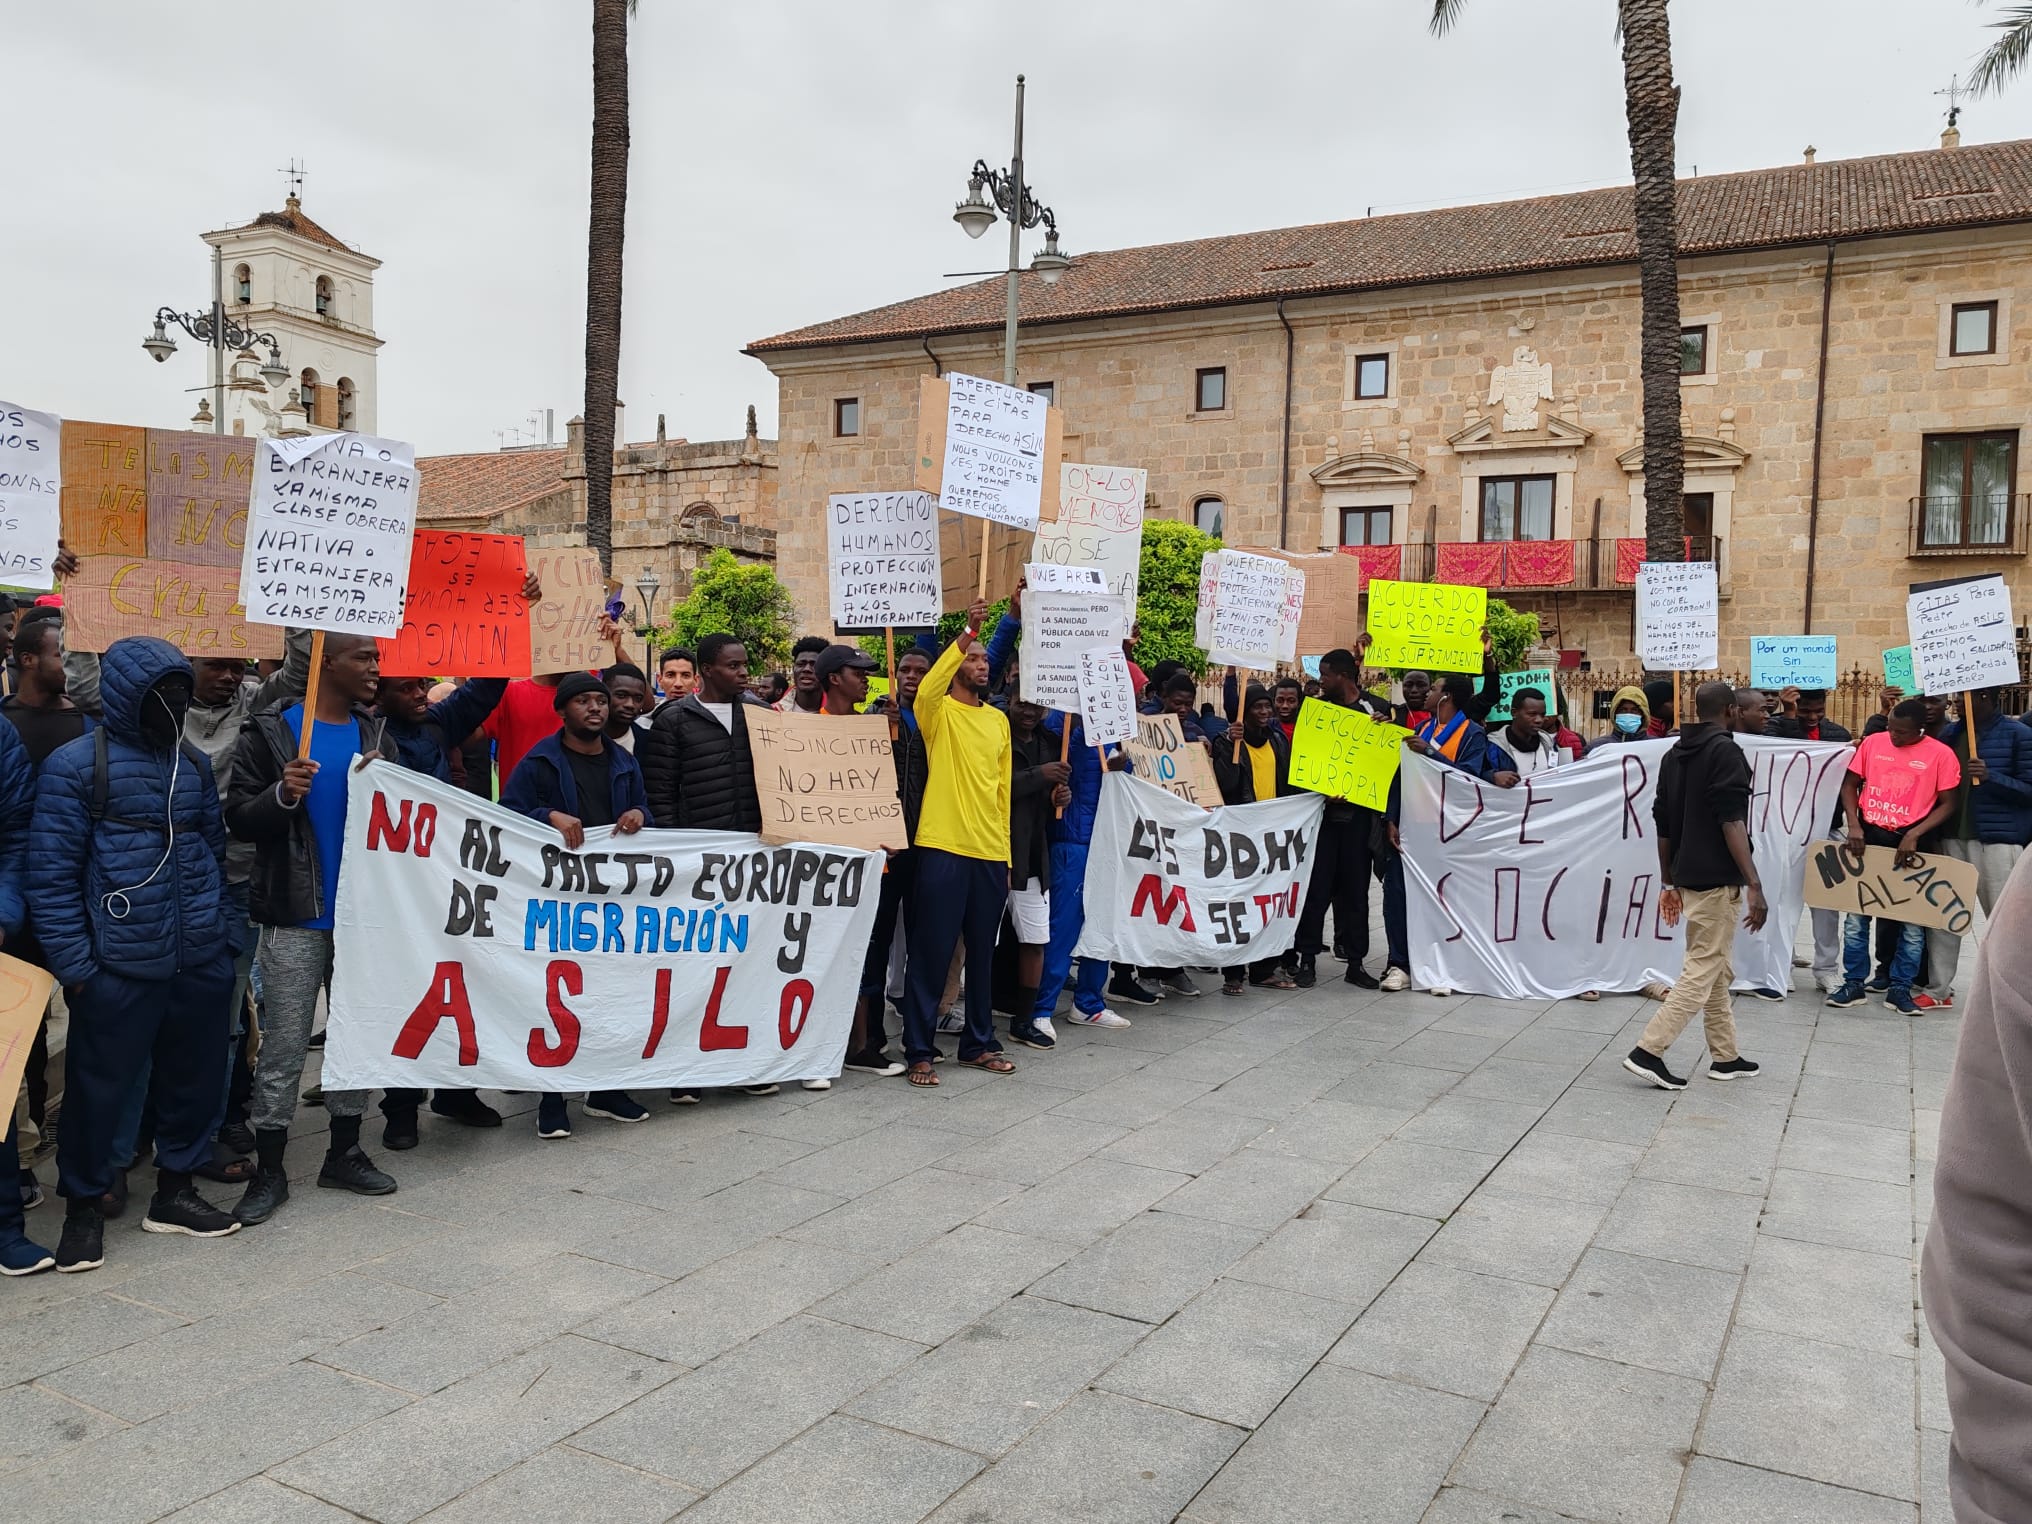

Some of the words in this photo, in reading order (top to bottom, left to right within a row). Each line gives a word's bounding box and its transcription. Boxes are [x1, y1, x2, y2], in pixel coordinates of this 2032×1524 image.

[952, 392, 976, 404] DE
[956, 377, 1035, 406] APERTURA
[950, 406, 992, 423] PARA
[954, 423, 1011, 443] DERECHO
[952, 443, 978, 457] NOUS
[985, 450, 1034, 470] VOULONS
[271, 454, 410, 494] ETRANJERA
[951, 456, 973, 469] LES
[1025, 473, 1038, 484] DE
[274, 479, 305, 497] LA
[949, 484, 1000, 502] QUEREMOS
[836, 494, 931, 525] DERECHOS
[947, 495, 1007, 514] DERECHOS
[273, 501, 338, 522] CLASE
[345, 512, 406, 535] OBRERA
[986, 512, 1029, 527] HUMANOS
[98, 514, 128, 546] R
[257, 529, 354, 557] NATIVA
[841, 530, 933, 553] HUMANOS
[1042, 537, 1072, 566] NO
[1080, 538, 1111, 560] SE
[841, 557, 935, 577] PROTECCIÓN
[1226, 554, 1286, 575] QUEREMOS
[449, 572, 475, 587] ES
[260, 580, 288, 598] LA
[296, 584, 366, 604] MISMA
[1372, 583, 1479, 613] ACUERDO
[1651, 600, 1660, 608] NO
[1663, 597, 1676, 606] CON
[1679, 596, 1688, 604] EL
[1966, 585, 1996, 600] Para
[266, 603, 329, 621] CLASE
[334, 607, 396, 626] OBRERA
[484, 592, 524, 617] SER
[843, 602, 854, 613] A
[861, 600, 891, 611] LOS
[845, 611, 938, 625] INMIGRANTES
[1216, 609, 1226, 617] EL
[1231, 612, 1278, 627] MINISTRO
[1373, 610, 1475, 636] EUROPEO
[1916, 611, 1952, 624] Pedir
[1041, 627, 1073, 637] PÚBLICA
[1214, 623, 1264, 637] INTERIOR
[1400, 646, 1483, 669] SUFRIMIENTO
[1682, 644, 1701, 652] FROM
[1757, 641, 1776, 654] Por
[1803, 641, 1836, 654] mundo
[1884, 652, 1901, 664] Por
[1924, 651, 1956, 664] APOYO
[1049, 674, 1077, 682] SANIDA
[1081, 653, 1096, 688] PARA
[1761, 671, 1823, 684] Fronteras
[1037, 684, 1067, 694] PÚBLICA
[1105, 720, 1115, 736] EL
[1330, 740, 1360, 764] DE
[778, 765, 816, 794] NO
[829, 767, 881, 792] HAY
[1296, 755, 1378, 805] EUROPA
[1439, 748, 1847, 847] DERHOS
[1869, 786, 1882, 797] TU
[776, 797, 901, 826] DERECHOS
[1868, 799, 1910, 816] DORSAL
[366, 790, 438, 858] NO
[459, 817, 512, 878] AL
[540, 843, 675, 897] PACTO
[691, 848, 868, 908] EUROPEO
[1815, 844, 1865, 889] NO
[1857, 875, 1911, 913] AL
[444, 878, 498, 938] DE
[524, 898, 749, 955] MIGRACIÓN
[1208, 901, 1251, 945] SE
[391, 959, 816, 1069] ASILO
